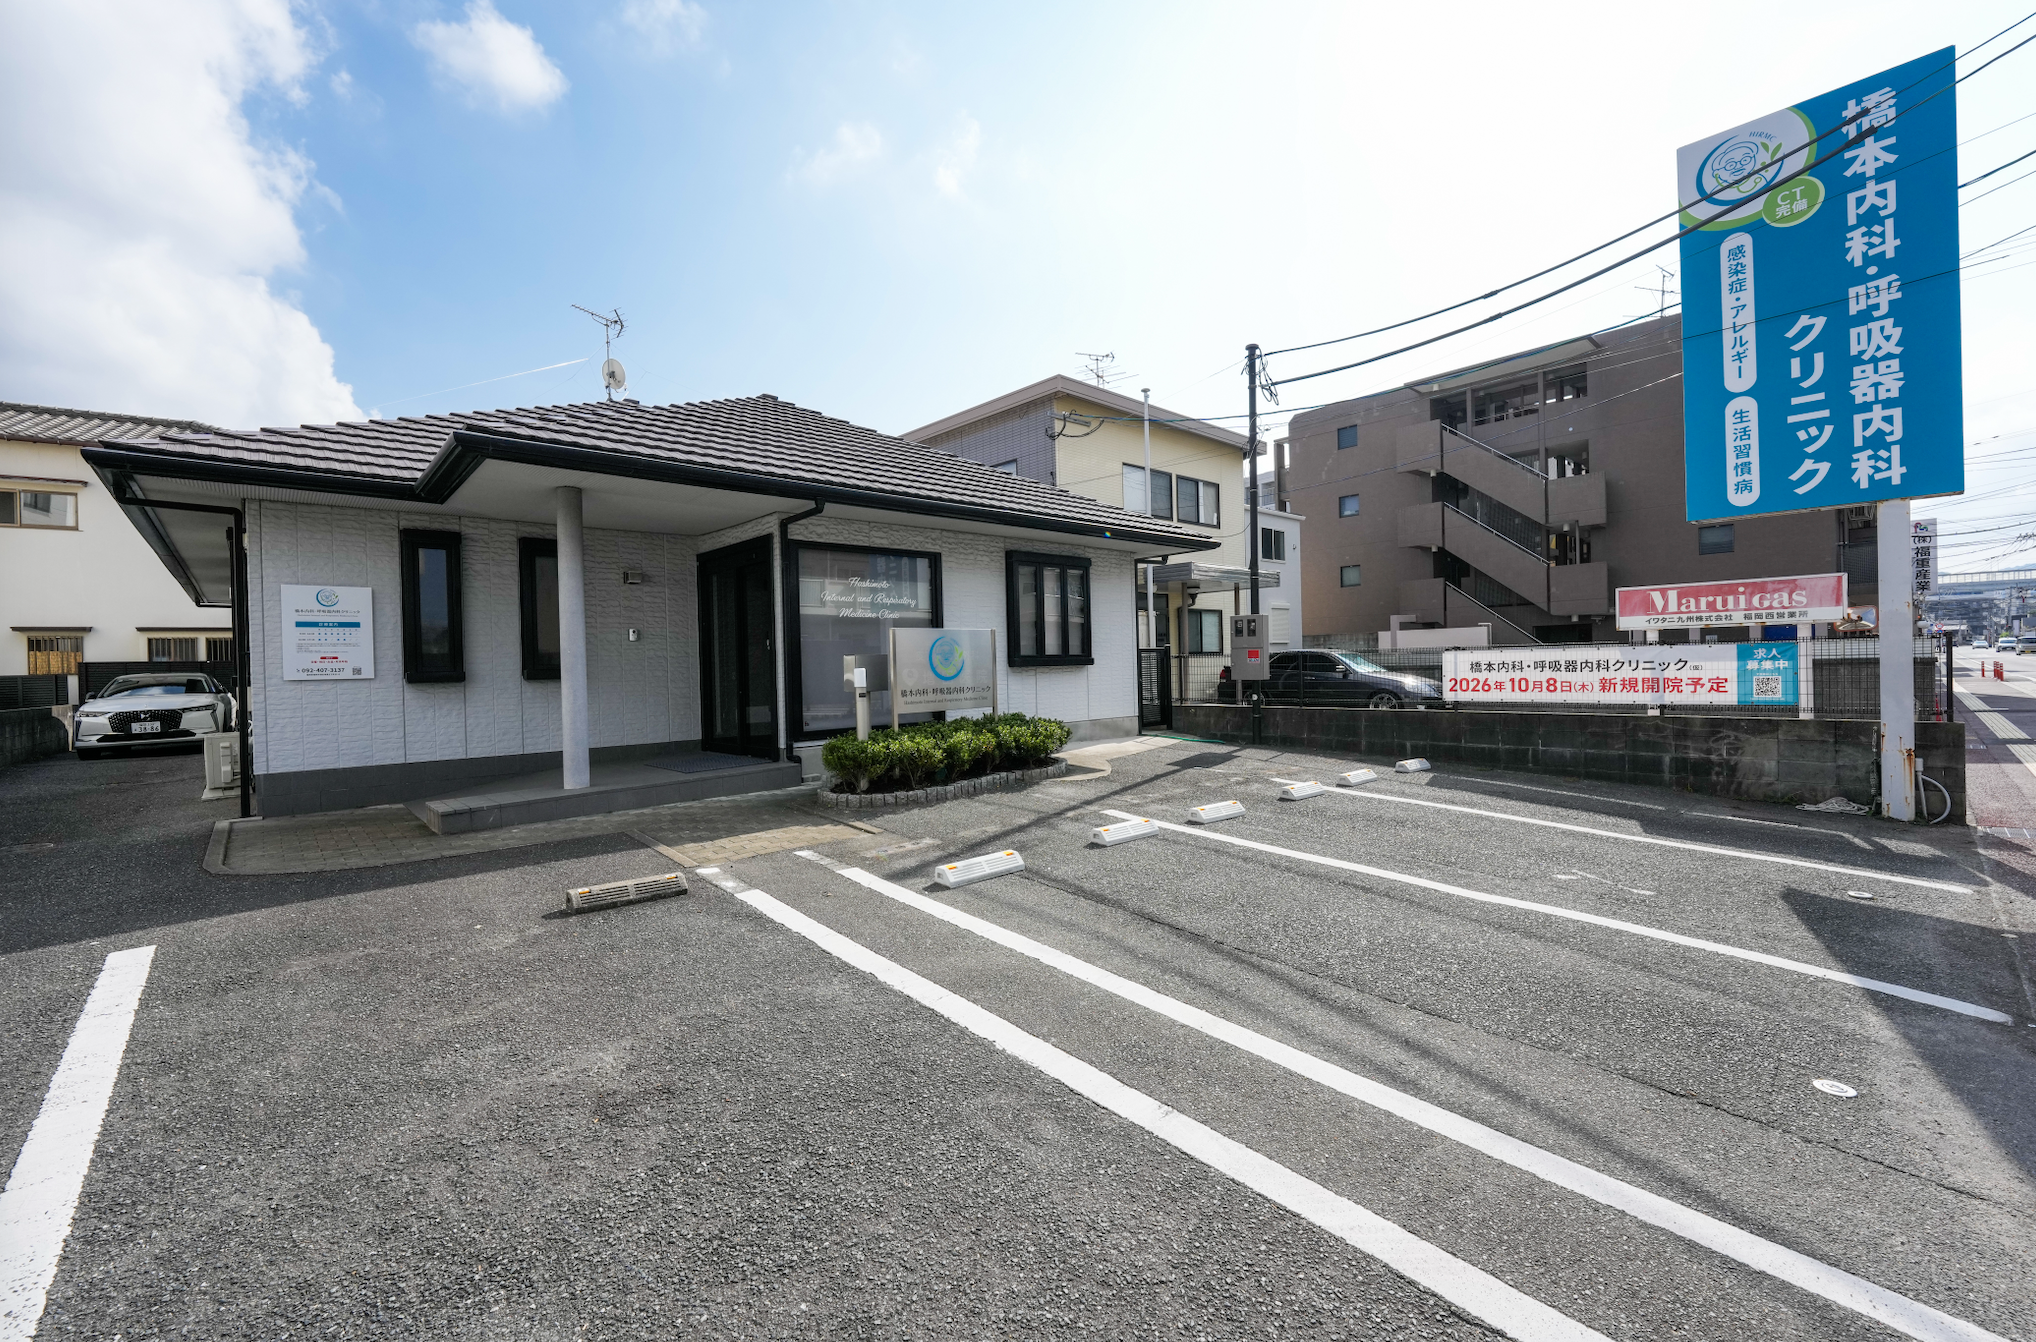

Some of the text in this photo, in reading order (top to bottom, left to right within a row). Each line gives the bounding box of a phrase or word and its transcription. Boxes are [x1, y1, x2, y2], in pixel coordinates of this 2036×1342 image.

[1777, 186, 1805, 203] CT
[1775, 199, 1808, 219] 完備
[1841, 86, 1907, 489] 橋本内科・呼吸器内科
[1727, 243, 1749, 379] 感染症・アレルギー
[1784, 314, 1835, 495] クリニック
[1732, 408, 1753, 495] 生活習慣病
[848, 577, 890, 589] Hashimoto
[820, 590, 917, 608] Internal and Respiratory
[839, 607, 900, 619] Medicine Clinic
[1645, 610, 1809, 625] イワタニ九州株式会社 福岡西営業所
[1753, 647, 1781, 659] 求人
[1746, 659, 1789, 671] 募集中
[900, 685, 991, 698] 橋本内科・呼吸器内科クリニック
[1449, 677, 1729, 694] 2026年10月8日(木) 新規開院予定
